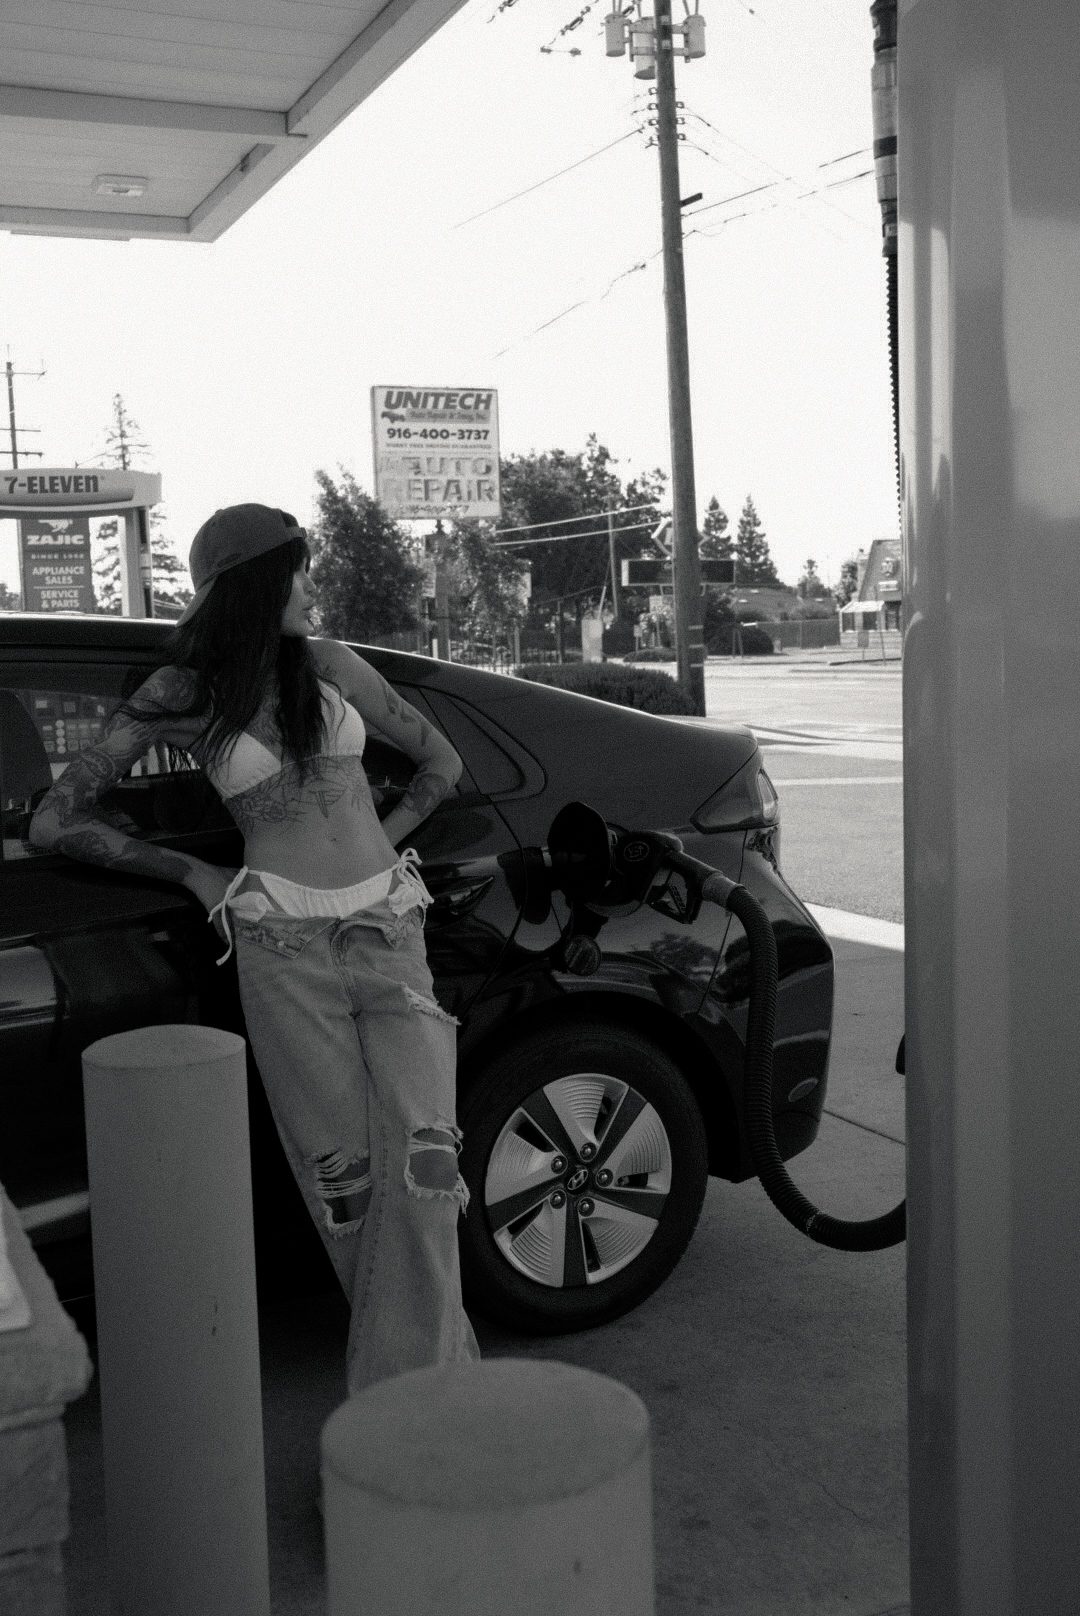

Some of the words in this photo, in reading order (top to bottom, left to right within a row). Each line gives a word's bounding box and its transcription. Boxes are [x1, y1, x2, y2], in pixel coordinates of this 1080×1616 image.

[384, 390, 493, 410] UNITECH
[386, 427, 490, 441] 916-400-3737
[383, 478, 495, 502] EPAIR
[26, 534, 85, 546] ZAJIC
[32, 566, 85, 576] APPLIANCE
[44, 575, 73, 584] SALES
[40, 589, 79, 599] SERVICE
[41, 600, 49, 608] &
[51, 599, 80, 608] PARTS
